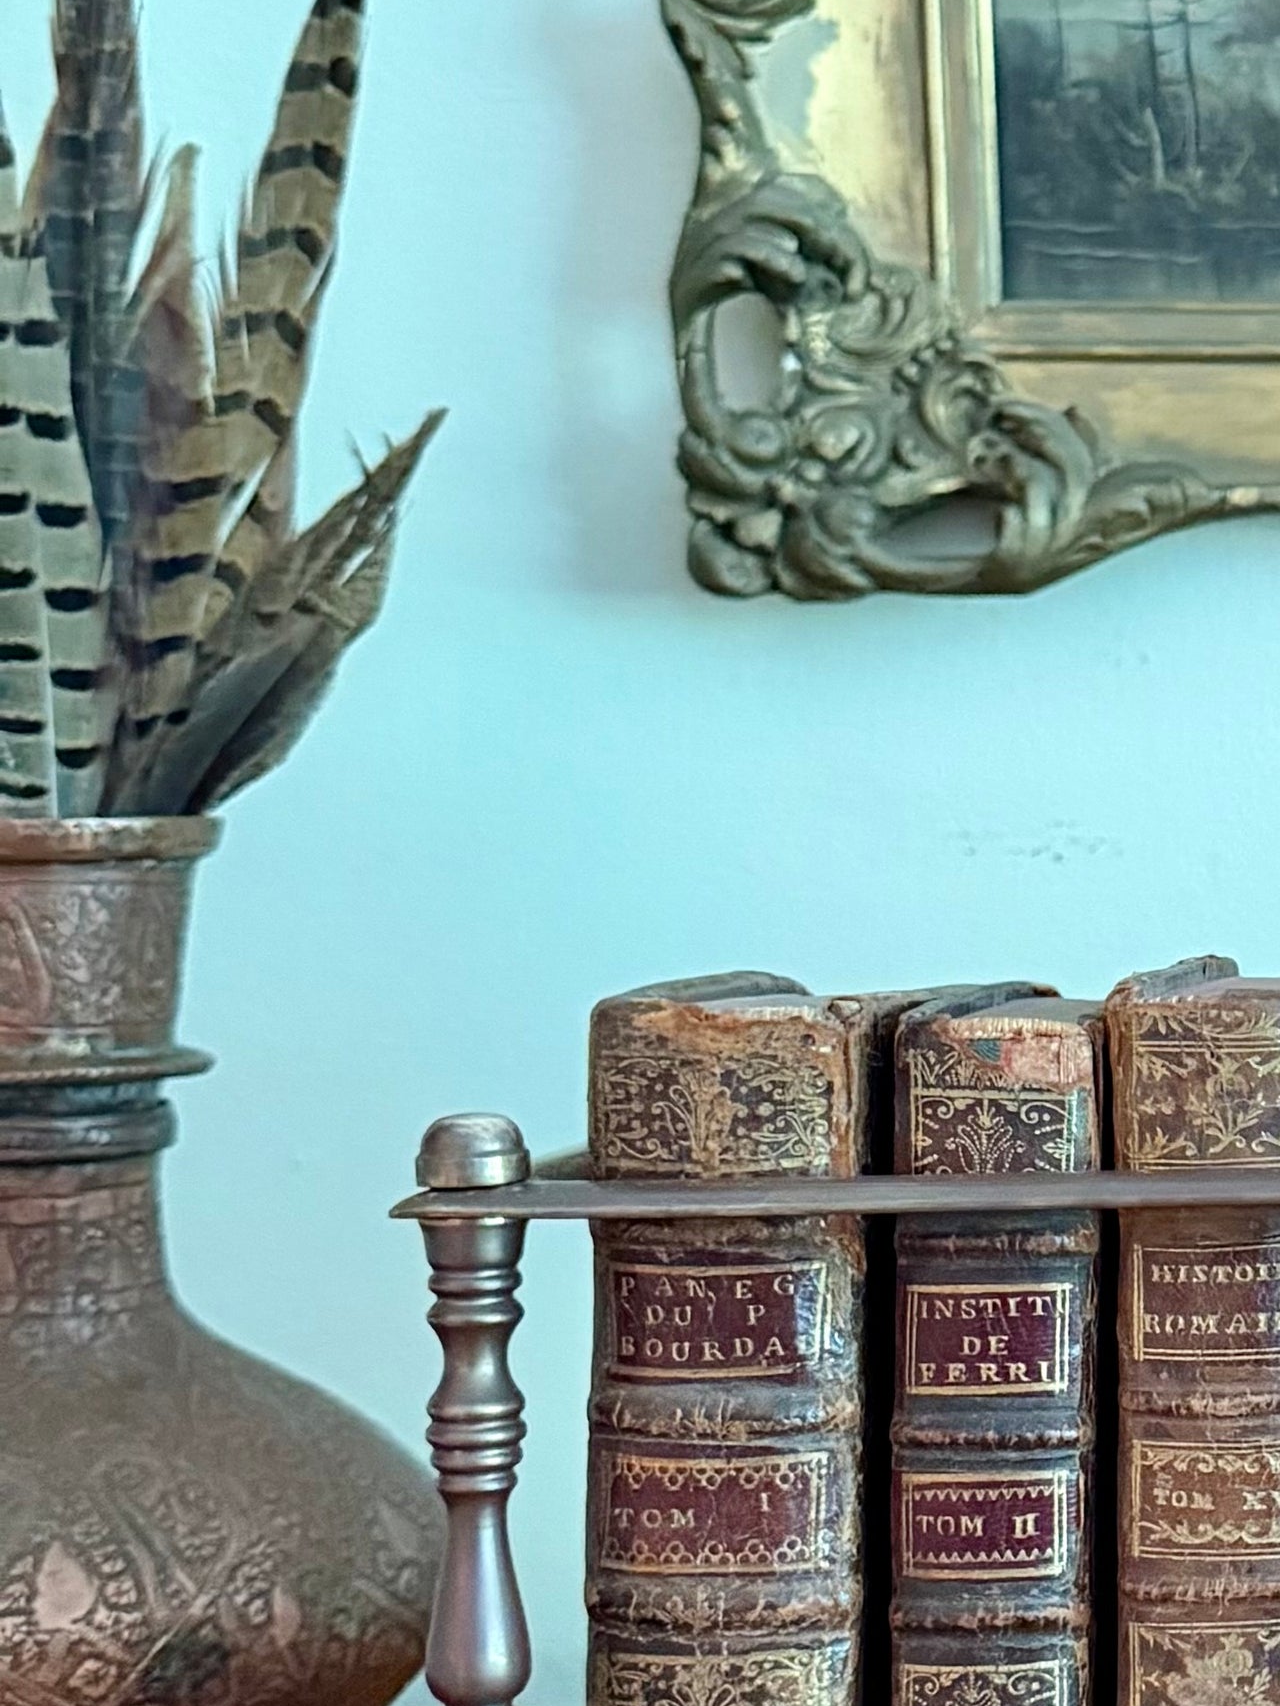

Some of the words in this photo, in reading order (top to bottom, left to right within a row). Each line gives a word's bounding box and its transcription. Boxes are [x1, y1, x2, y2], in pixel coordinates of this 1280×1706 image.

[621, 1274, 795, 1299] PANEG
[646, 1305, 692, 1325] DU
[747, 1304, 765, 1326] P
[920, 1296, 1052, 1320] INSTIT
[959, 1335, 1009, 1355] DE
[1153, 1488, 1215, 1510] TOM
[613, 1508, 695, 1528] TOM
[916, 1515, 985, 1537] TOM
[1012, 1513, 1041, 1539] II
